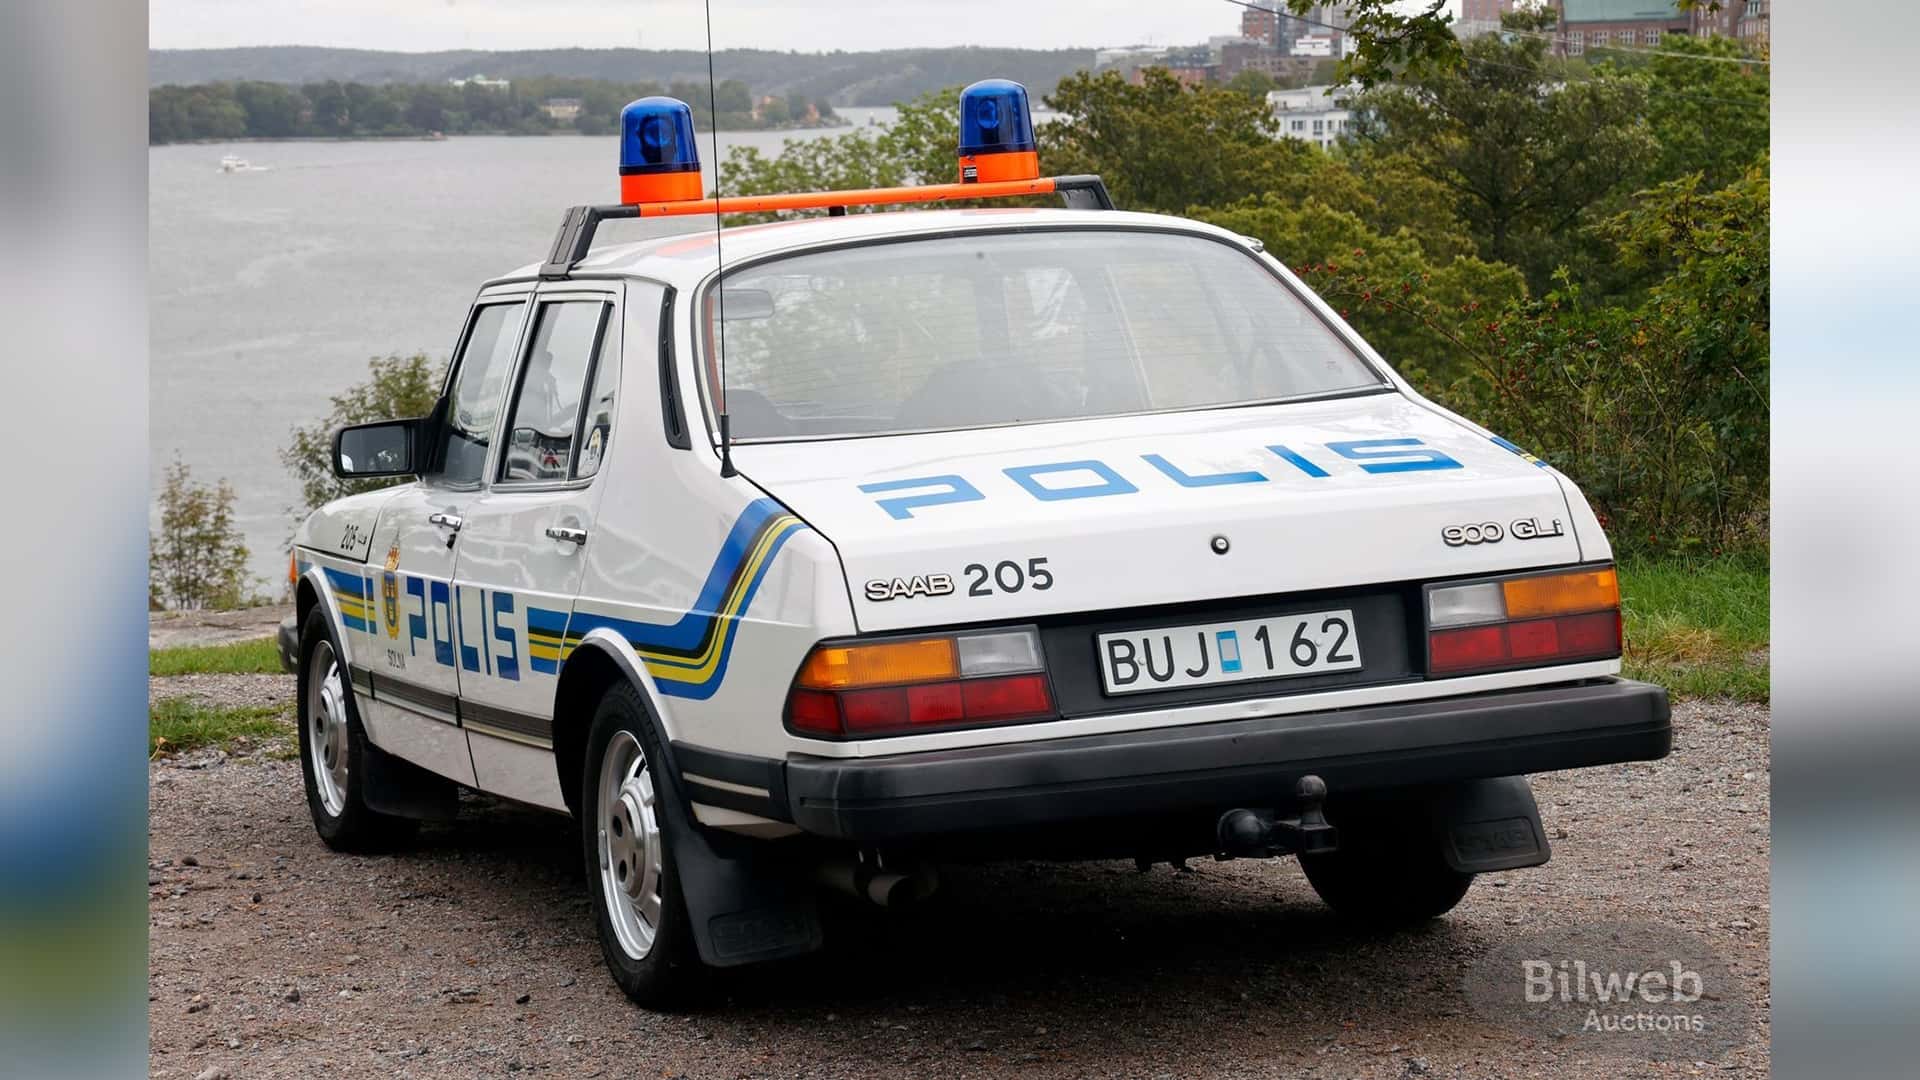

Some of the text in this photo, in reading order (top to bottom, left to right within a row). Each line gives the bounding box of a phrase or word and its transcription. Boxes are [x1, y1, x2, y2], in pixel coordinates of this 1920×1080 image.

[857, 437, 1464, 520] POLIS
[1442, 522, 1504, 547] 900
[865, 557, 1053, 601] SAAB 205
[406, 575, 520, 681] POLIS
[1107, 617, 1354, 686] BUJ 162
